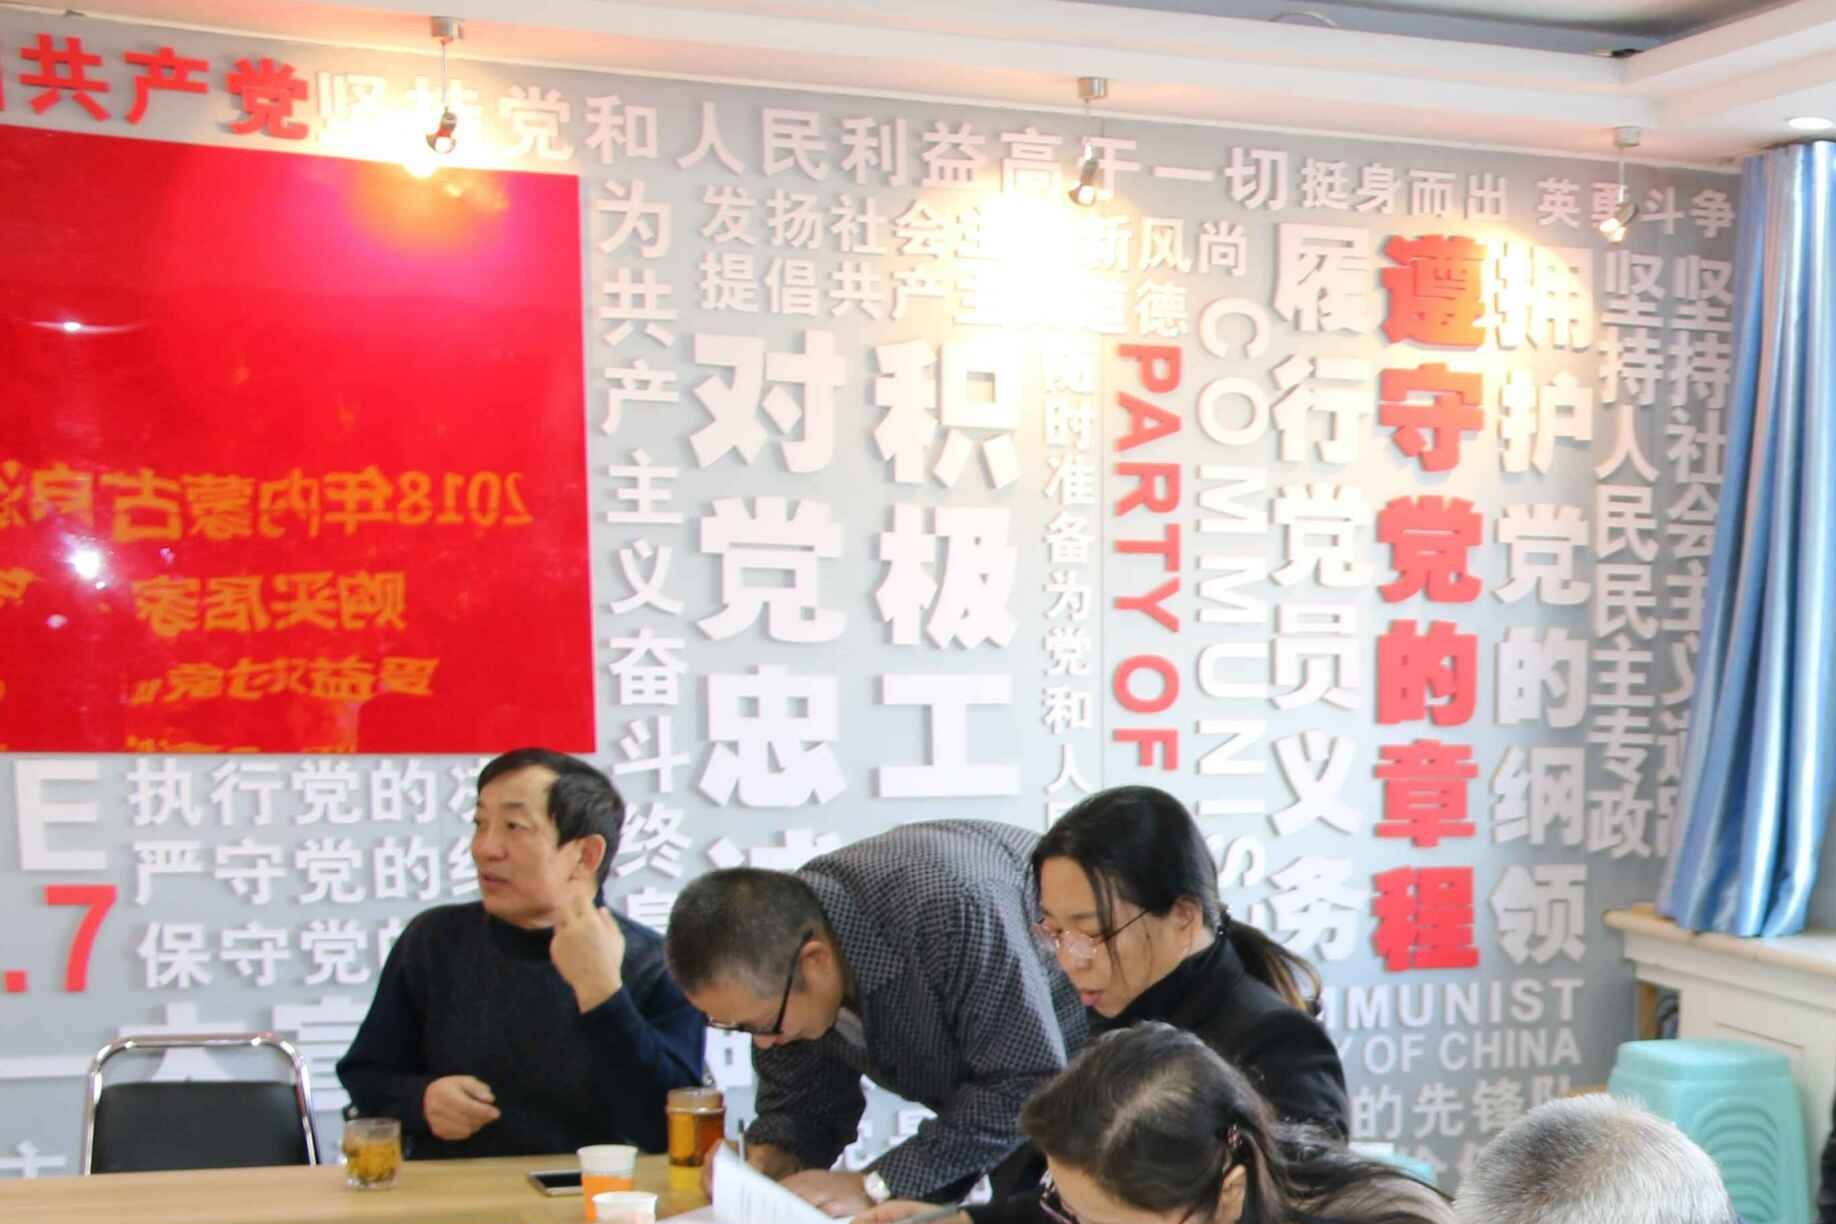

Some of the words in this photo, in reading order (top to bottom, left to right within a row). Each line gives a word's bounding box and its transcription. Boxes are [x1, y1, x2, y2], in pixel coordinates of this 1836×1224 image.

[0, 32, 311, 141] 共产党
[700, 184, 1247, 277] 发扬社会新风尚
[698, 252, 1188, 338] 提倡共产德
[688, 329, 848, 873] 对党忠
[872, 338, 1022, 798] 积极工
[1113, 343, 1182, 634] PARTY
[1195, 297, 1271, 926] COMMUNIS
[1272, 222, 1376, 962] 履行党员义务
[1372, 233, 1488, 974] 遵守党的章程
[1488, 238, 1594, 965] 拥护党的纲领
[1586, 250, 1666, 860] 坚持人民民主专政
[1111, 654, 1181, 773] OF
[138, 918, 402, 989] 保守党
[1363, 1031, 1427, 1075] OF
[1440, 1026, 1584, 1072] CHINA
